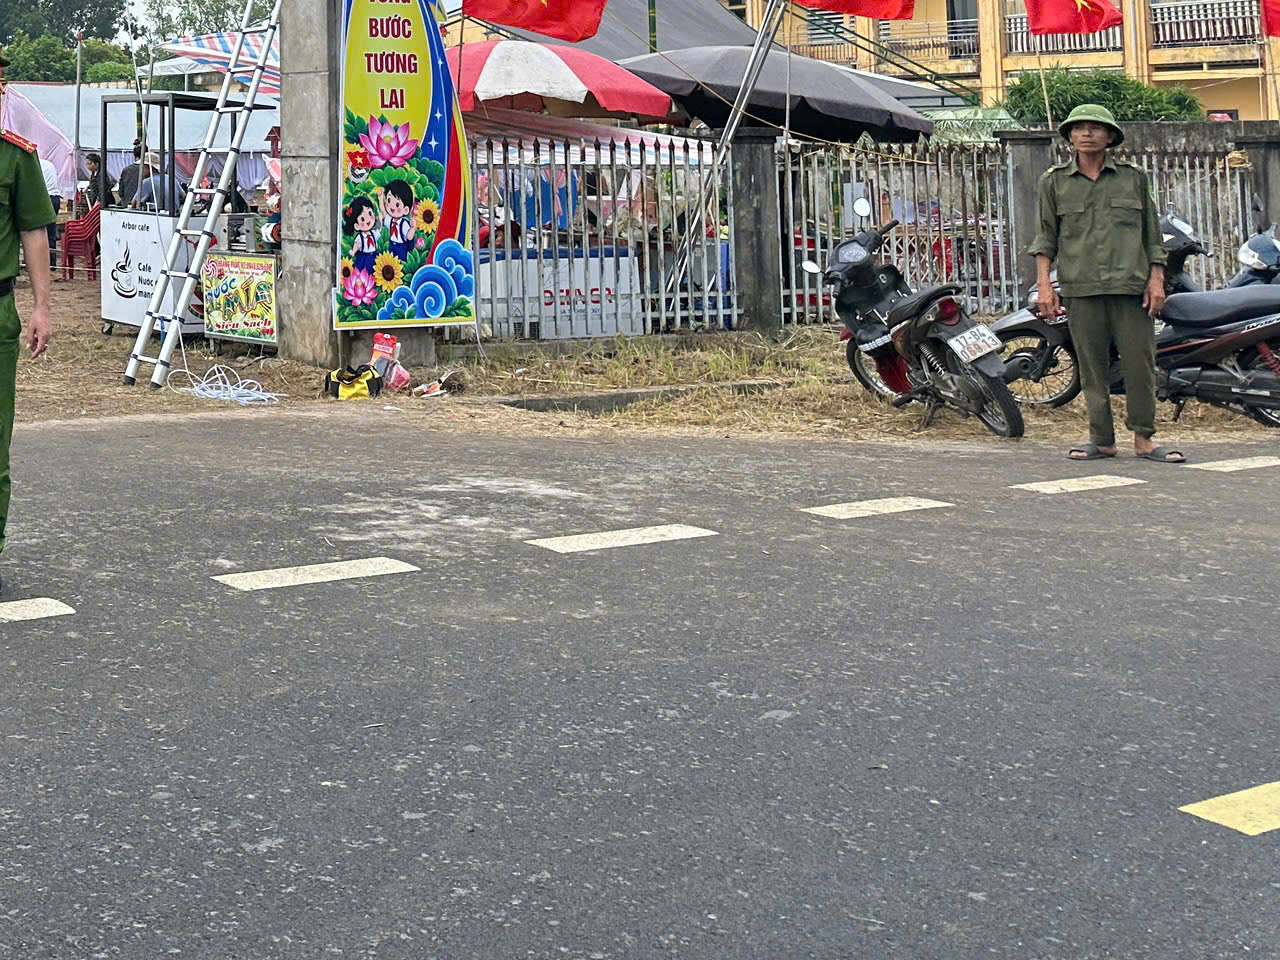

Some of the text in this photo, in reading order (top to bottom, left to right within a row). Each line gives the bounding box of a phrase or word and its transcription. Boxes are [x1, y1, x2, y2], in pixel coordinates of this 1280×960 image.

[368, 14, 412, 39] BƯỚC
[364, 51, 418, 74] TƯƠNG
[380, 88, 405, 109] LAI
